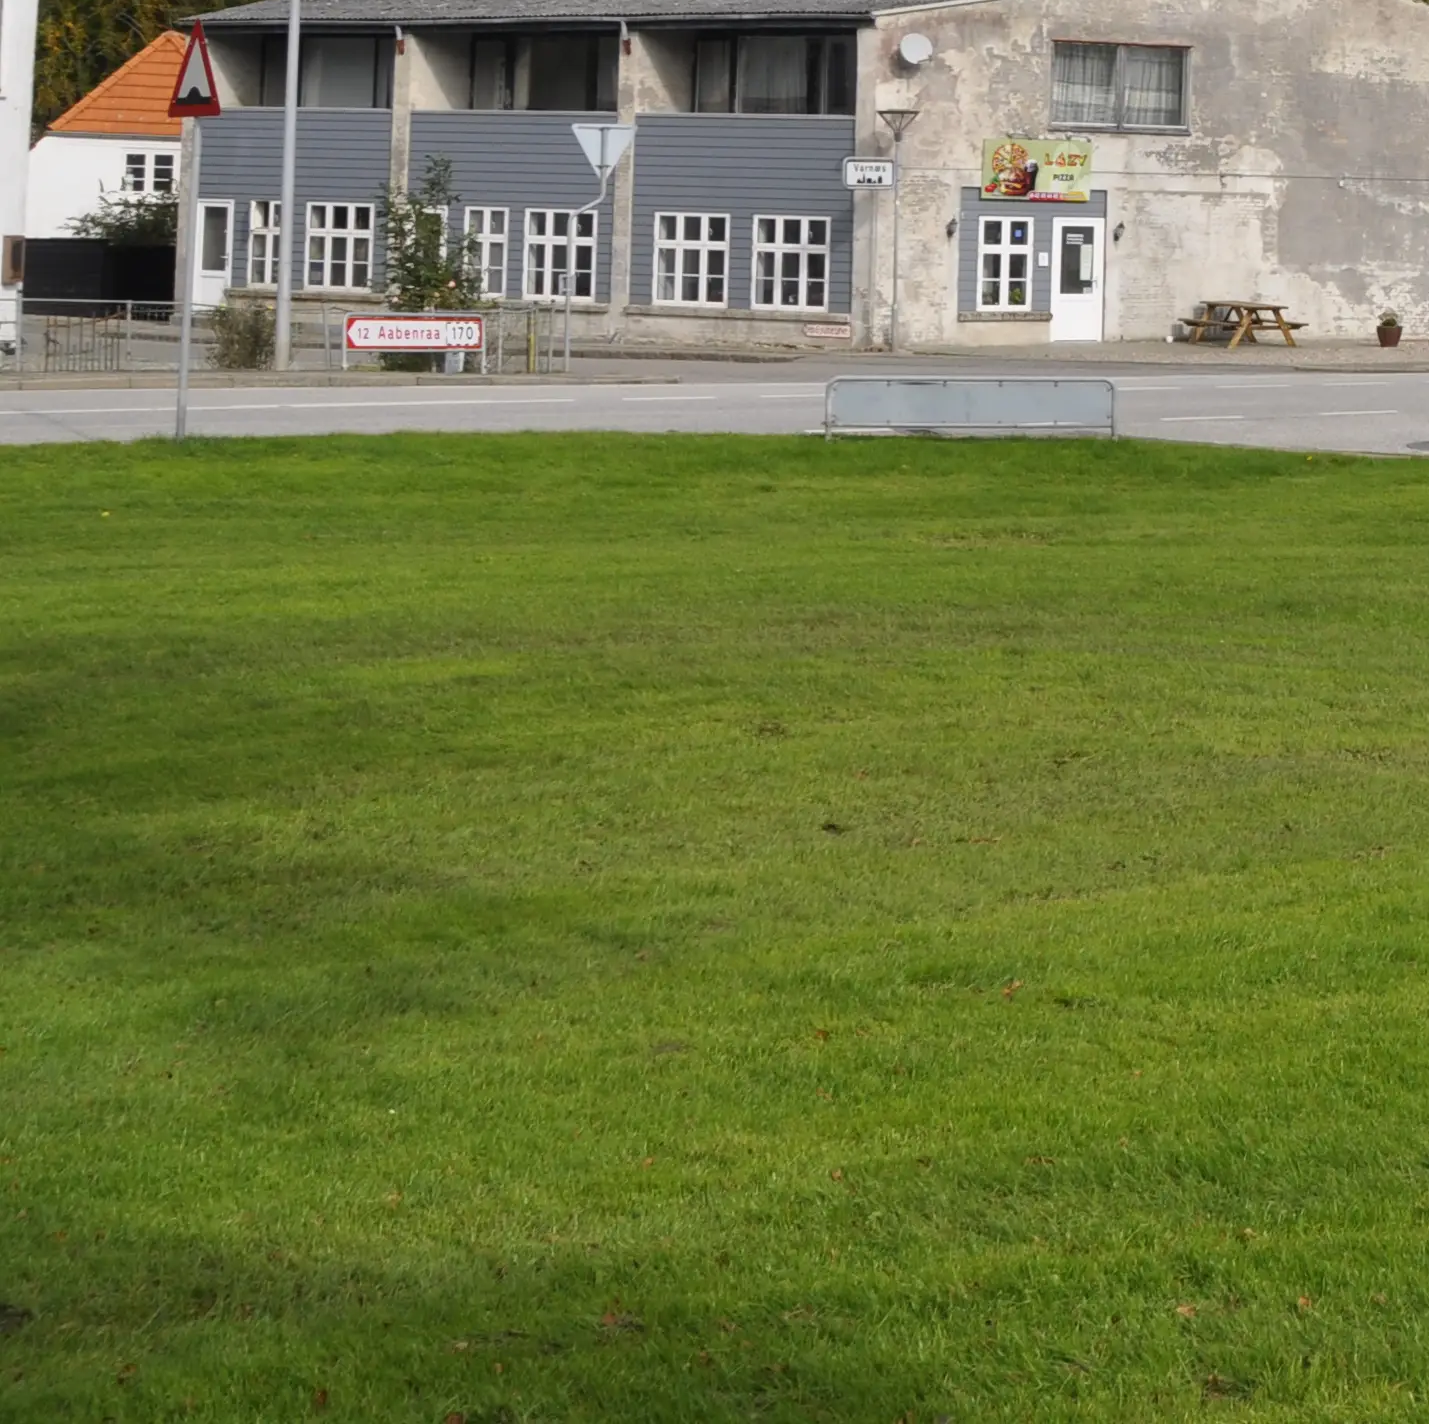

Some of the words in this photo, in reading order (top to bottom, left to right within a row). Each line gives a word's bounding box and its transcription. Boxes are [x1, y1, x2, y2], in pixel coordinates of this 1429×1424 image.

[1043, 152, 1088, 167] LAZY
[1052, 174, 1075, 182] PIZZA
[357, 327, 370, 340] 12
[378, 325, 441, 341] Aabenraa
[451, 326, 475, 341] 170
